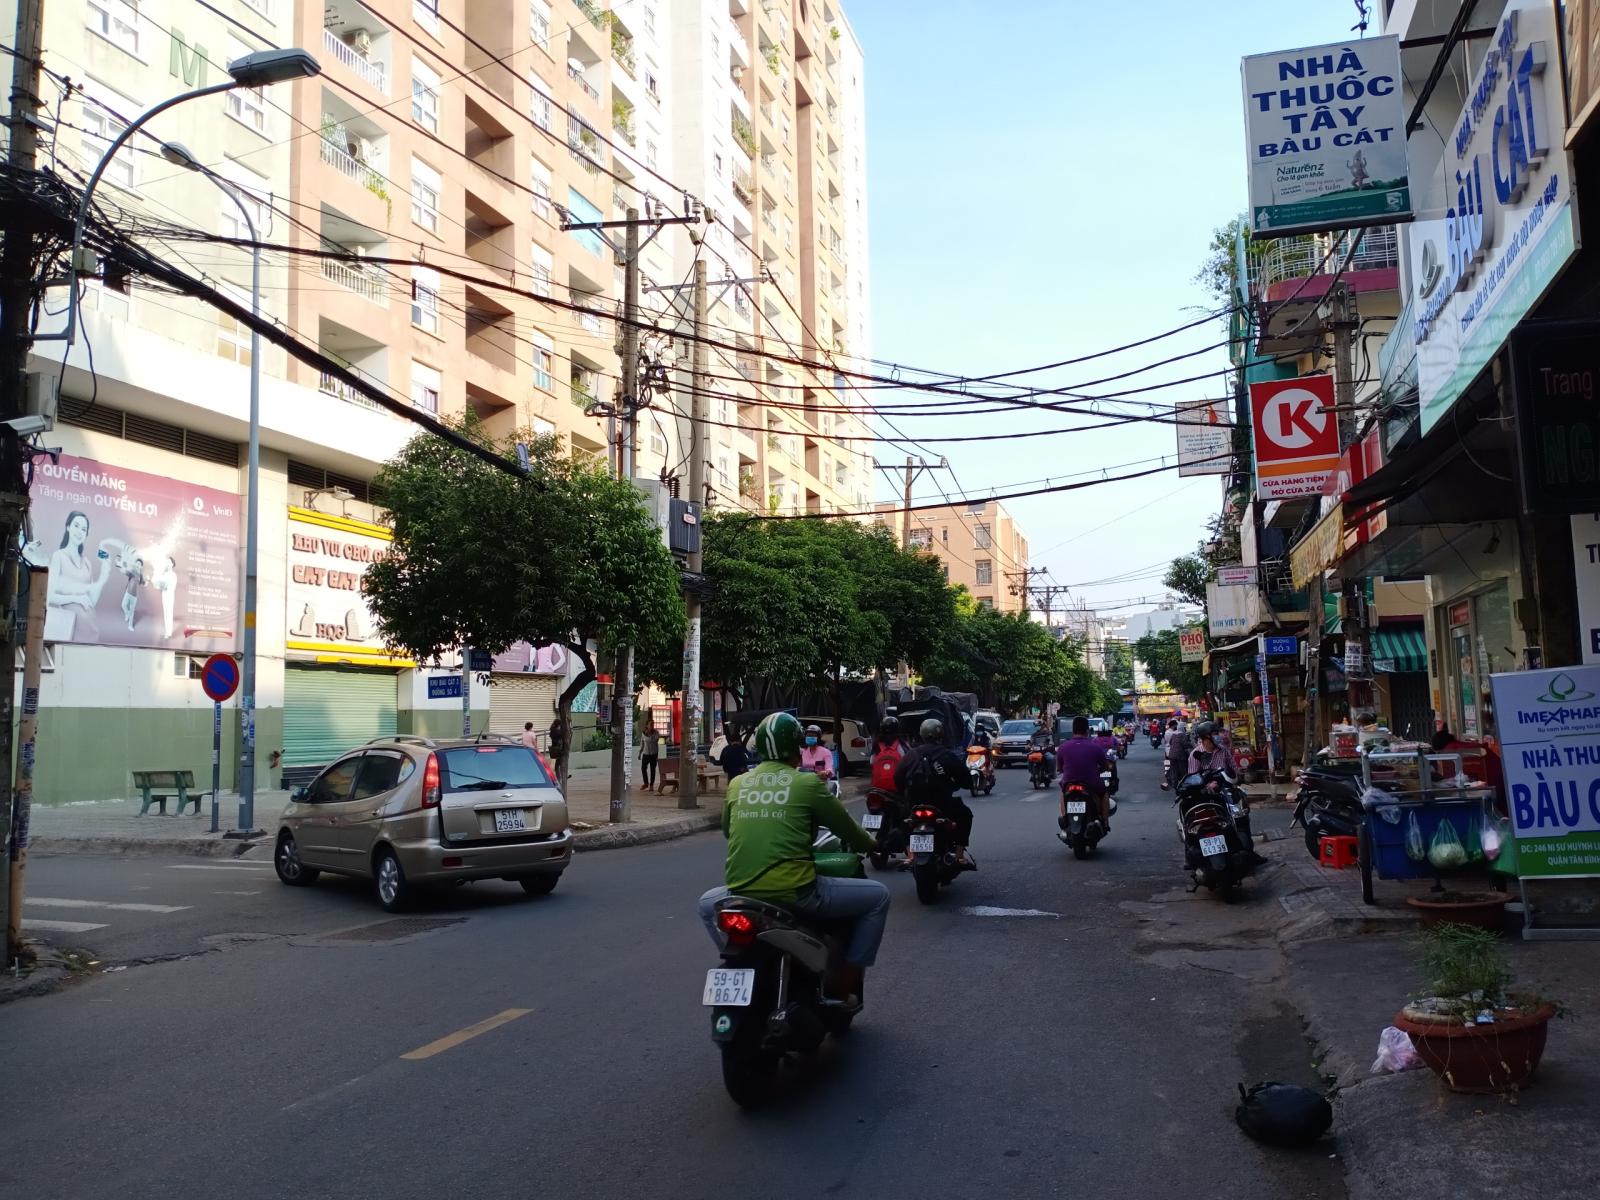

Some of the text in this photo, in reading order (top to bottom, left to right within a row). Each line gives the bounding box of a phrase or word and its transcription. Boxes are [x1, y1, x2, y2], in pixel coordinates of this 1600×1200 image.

[1278, 47, 1364, 81] NHÀ
[1252, 70, 1395, 112] THUỐC
[1282, 105, 1366, 134] TÂY
[1258, 127, 1394, 157] BÀU CÁT
[1447, 154, 1483, 294] BÀU
[1539, 367, 1593, 400] Trang
[42, 465, 89, 485] QUYỀN
[90, 472, 127, 492] NĂNG
[1281, 477, 1305, 486] HÀNG
[1305, 475, 1324, 484] TIỆN
[38, 484, 65, 501] Tăng
[94, 494, 137, 515] QUYỀN
[293, 534, 319, 553] KHU
[321, 539, 341, 558] VUI
[1522, 745, 1562, 769] NHÀ
[742, 770, 793, 787] Grab
[738, 786, 790, 805] Food
[1512, 772, 1580, 830] BÀU
[714, 972, 747, 986] 59-G1
